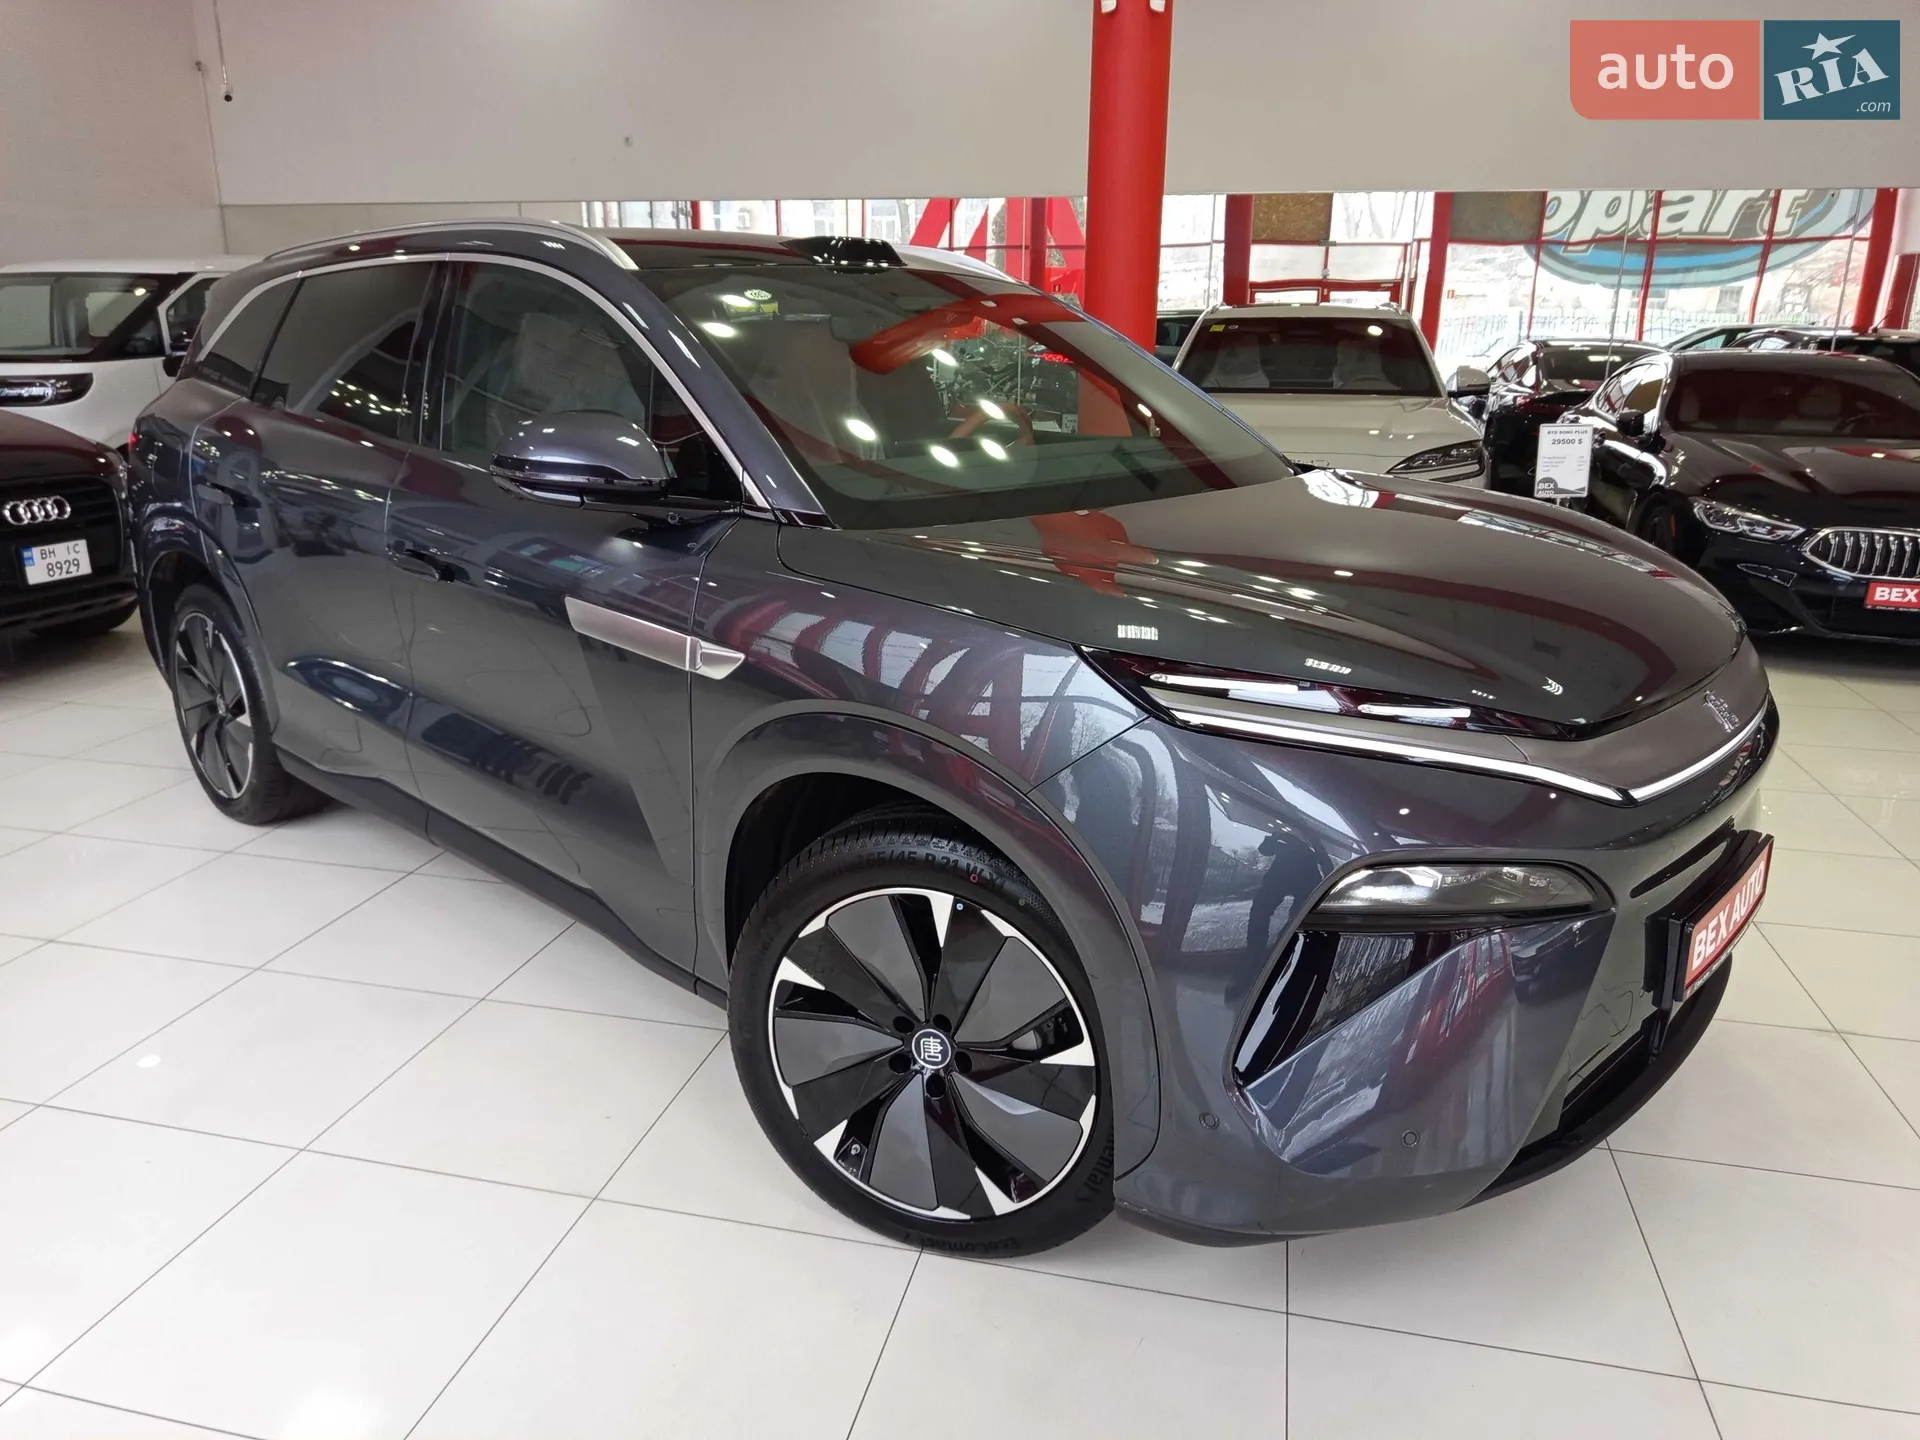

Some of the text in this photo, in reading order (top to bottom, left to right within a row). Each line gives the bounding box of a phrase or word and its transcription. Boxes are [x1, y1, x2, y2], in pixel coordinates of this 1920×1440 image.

[40, 543, 80, 560] BH IC
[46, 558, 80, 577] 8929
[1873, 586, 1920, 603] BEX
[1691, 903, 1731, 971] BEX
[1729, 860, 1765, 933] AUTO
